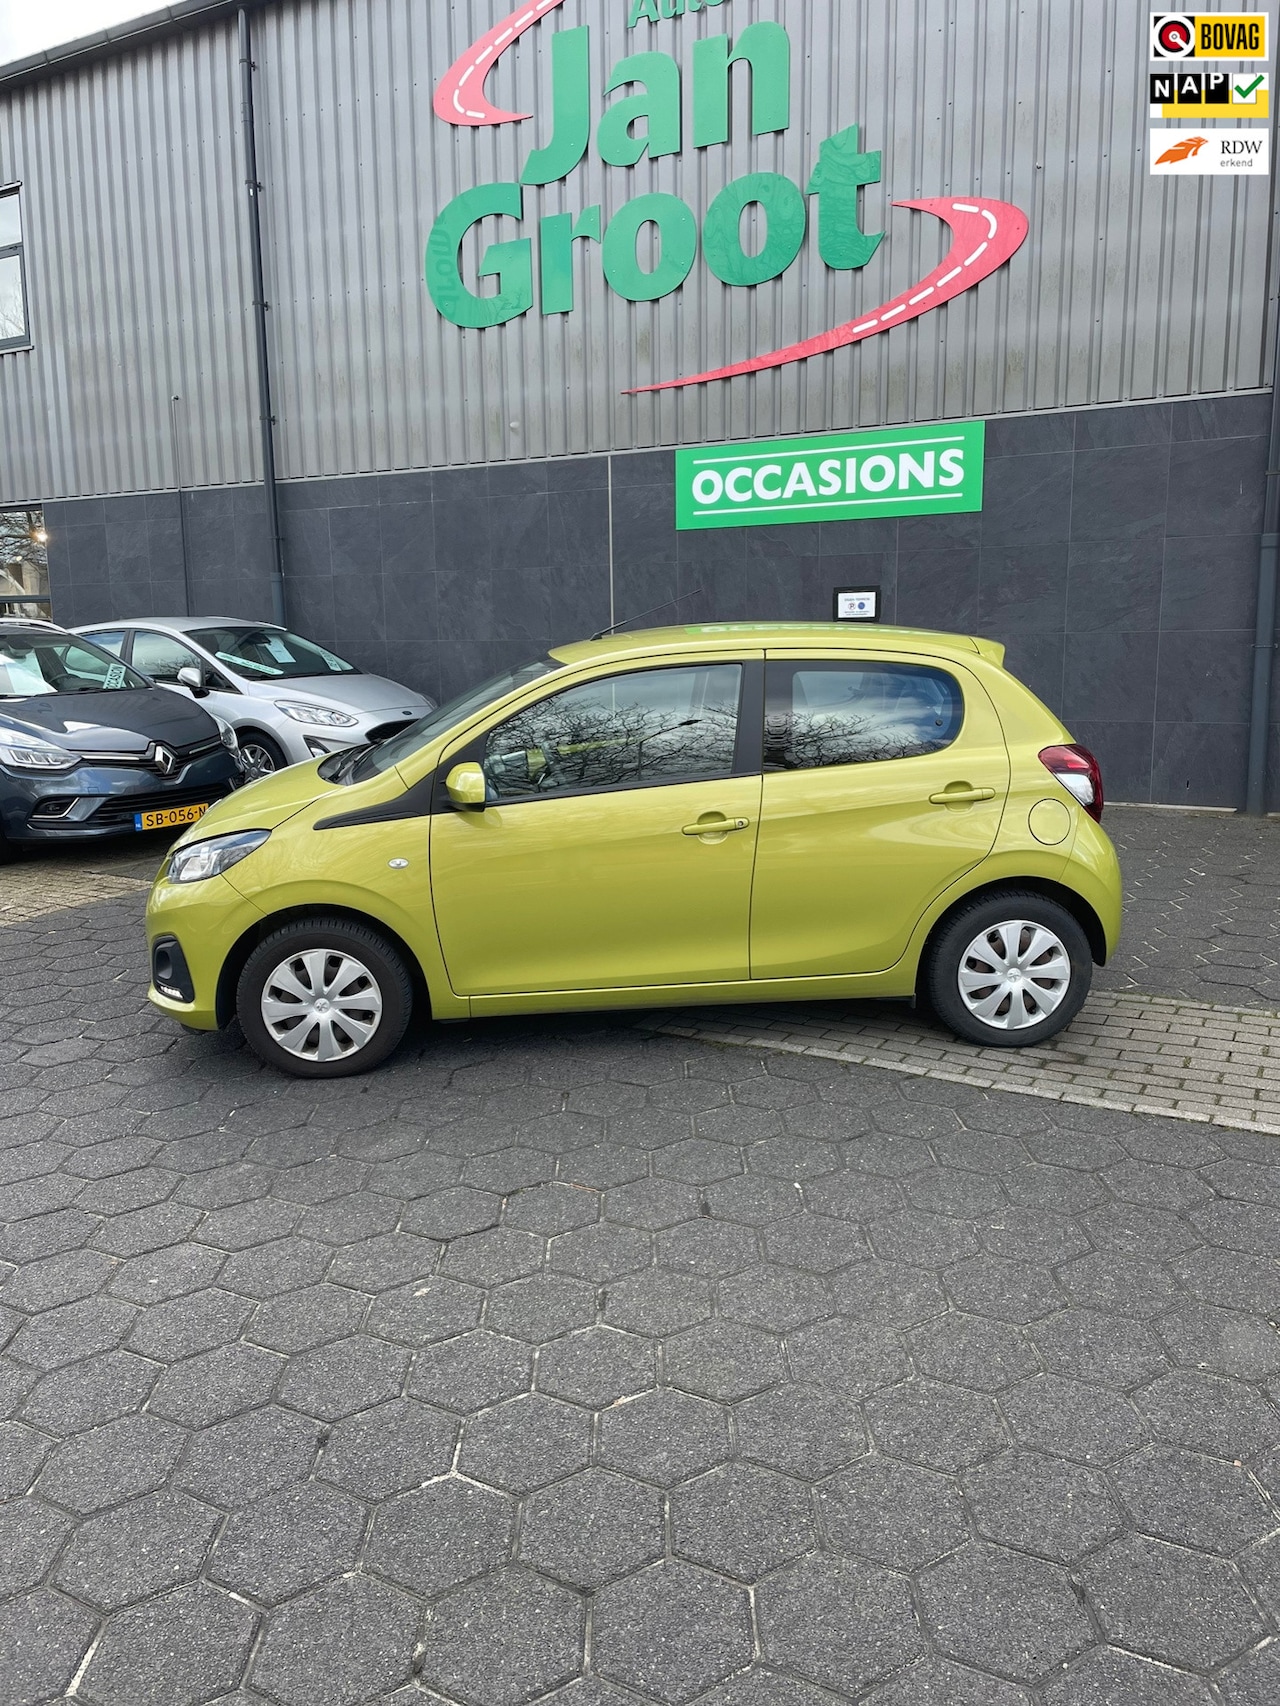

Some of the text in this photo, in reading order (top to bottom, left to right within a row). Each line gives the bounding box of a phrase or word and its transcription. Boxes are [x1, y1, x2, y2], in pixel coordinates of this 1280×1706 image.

[520, 20, 790, 185] Jan
[425, 123, 885, 329] Groot
[692, 449, 964, 504] OCCASIONS
